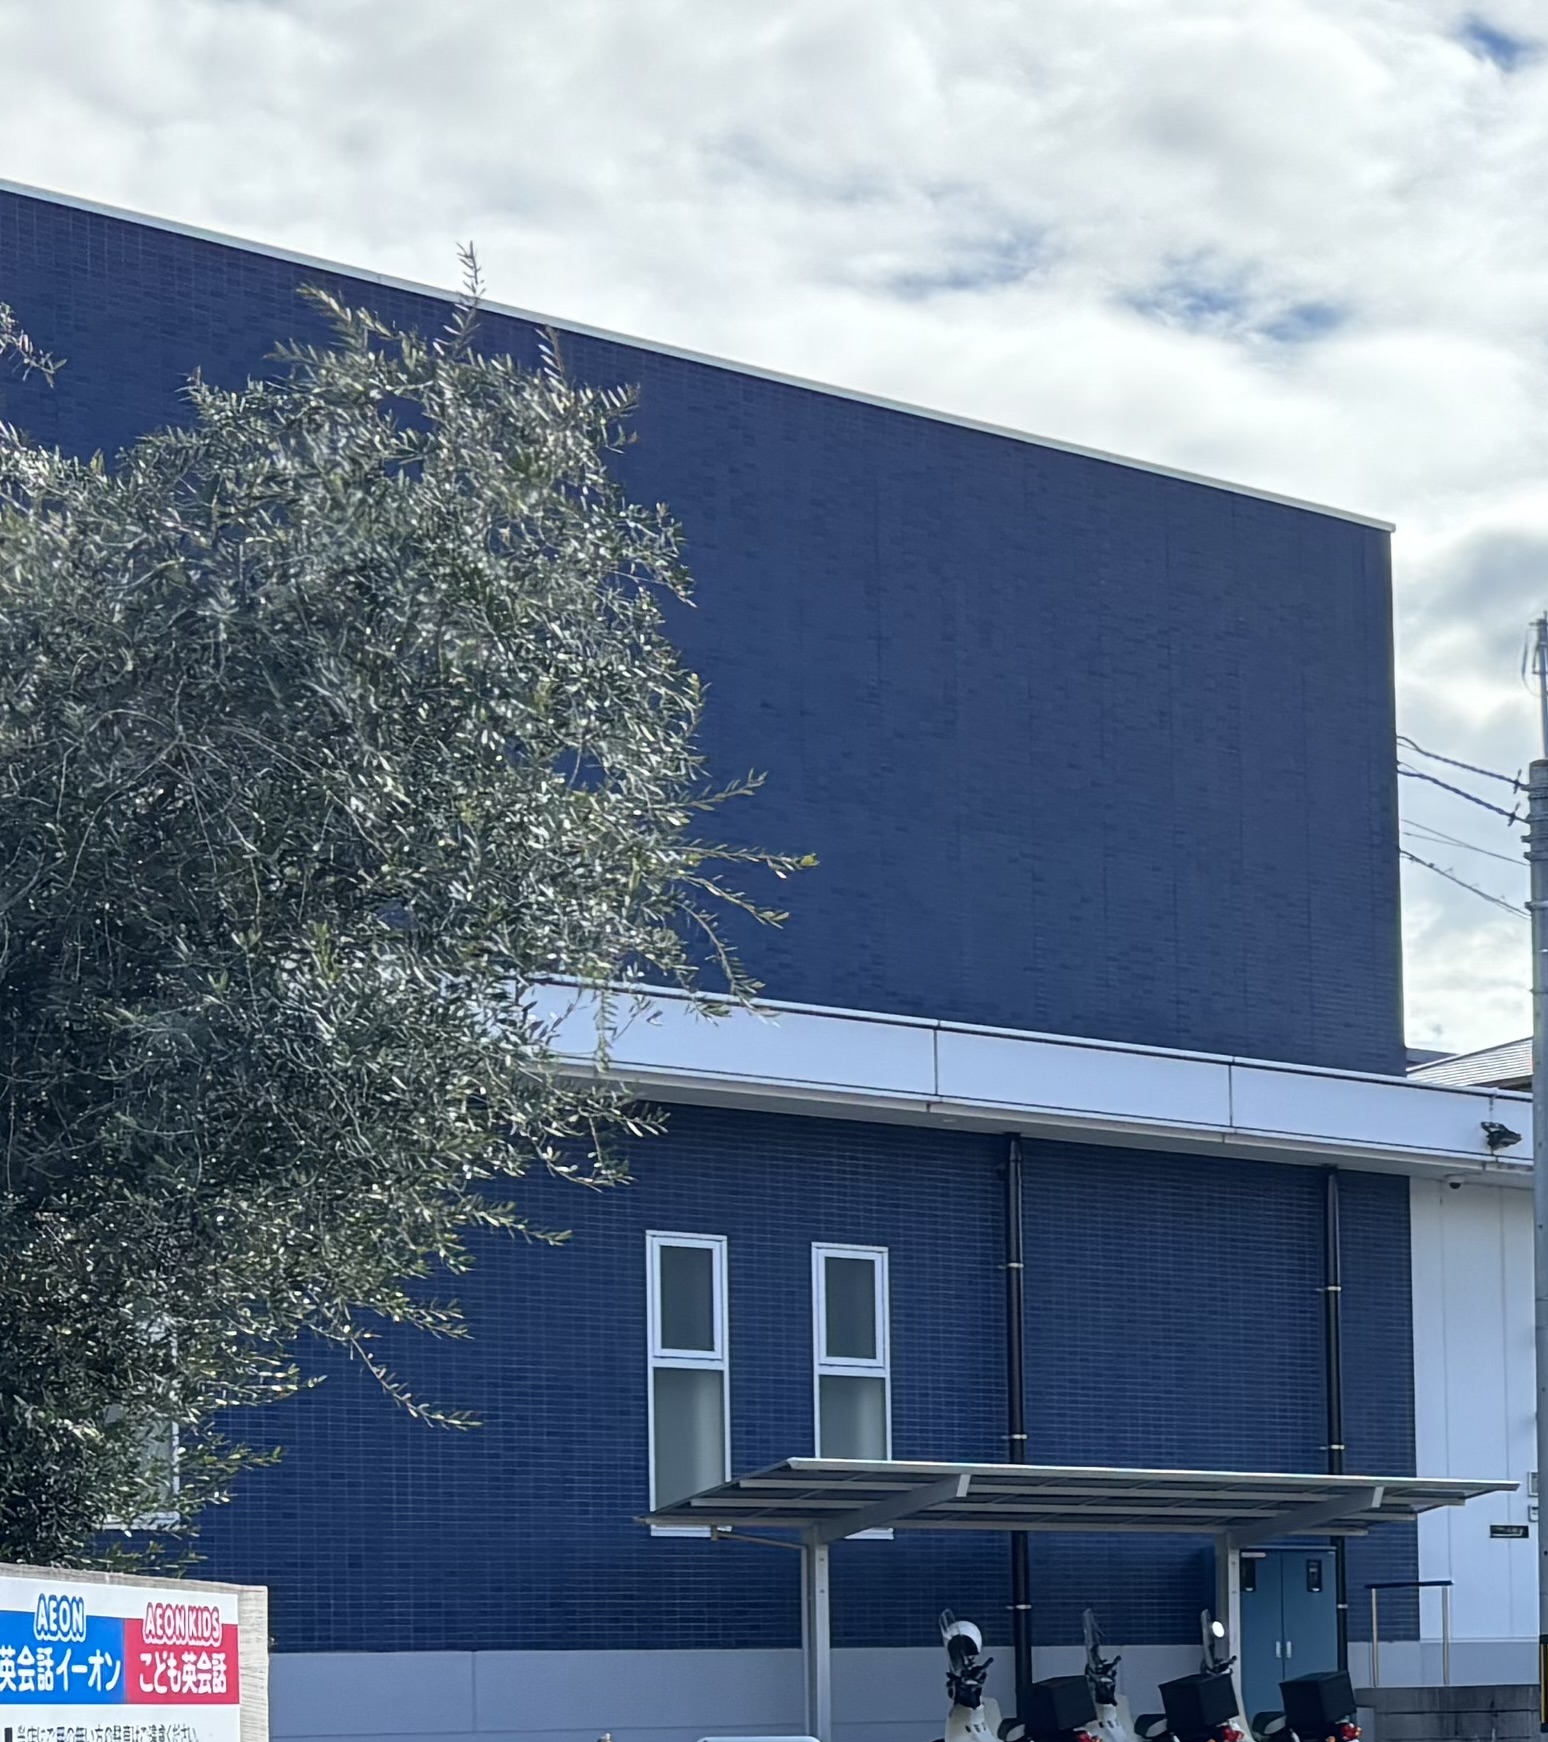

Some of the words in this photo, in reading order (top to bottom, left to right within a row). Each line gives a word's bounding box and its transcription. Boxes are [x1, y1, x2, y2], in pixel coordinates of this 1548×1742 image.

[35, 1593, 86, 1641] AEON
[144, 1602, 187, 1643] AEON
[187, 1605, 222, 1645] KIDS
[0, 1645, 121, 1692] 英会話イーオン
[139, 1651, 227, 1694] こども英会話
